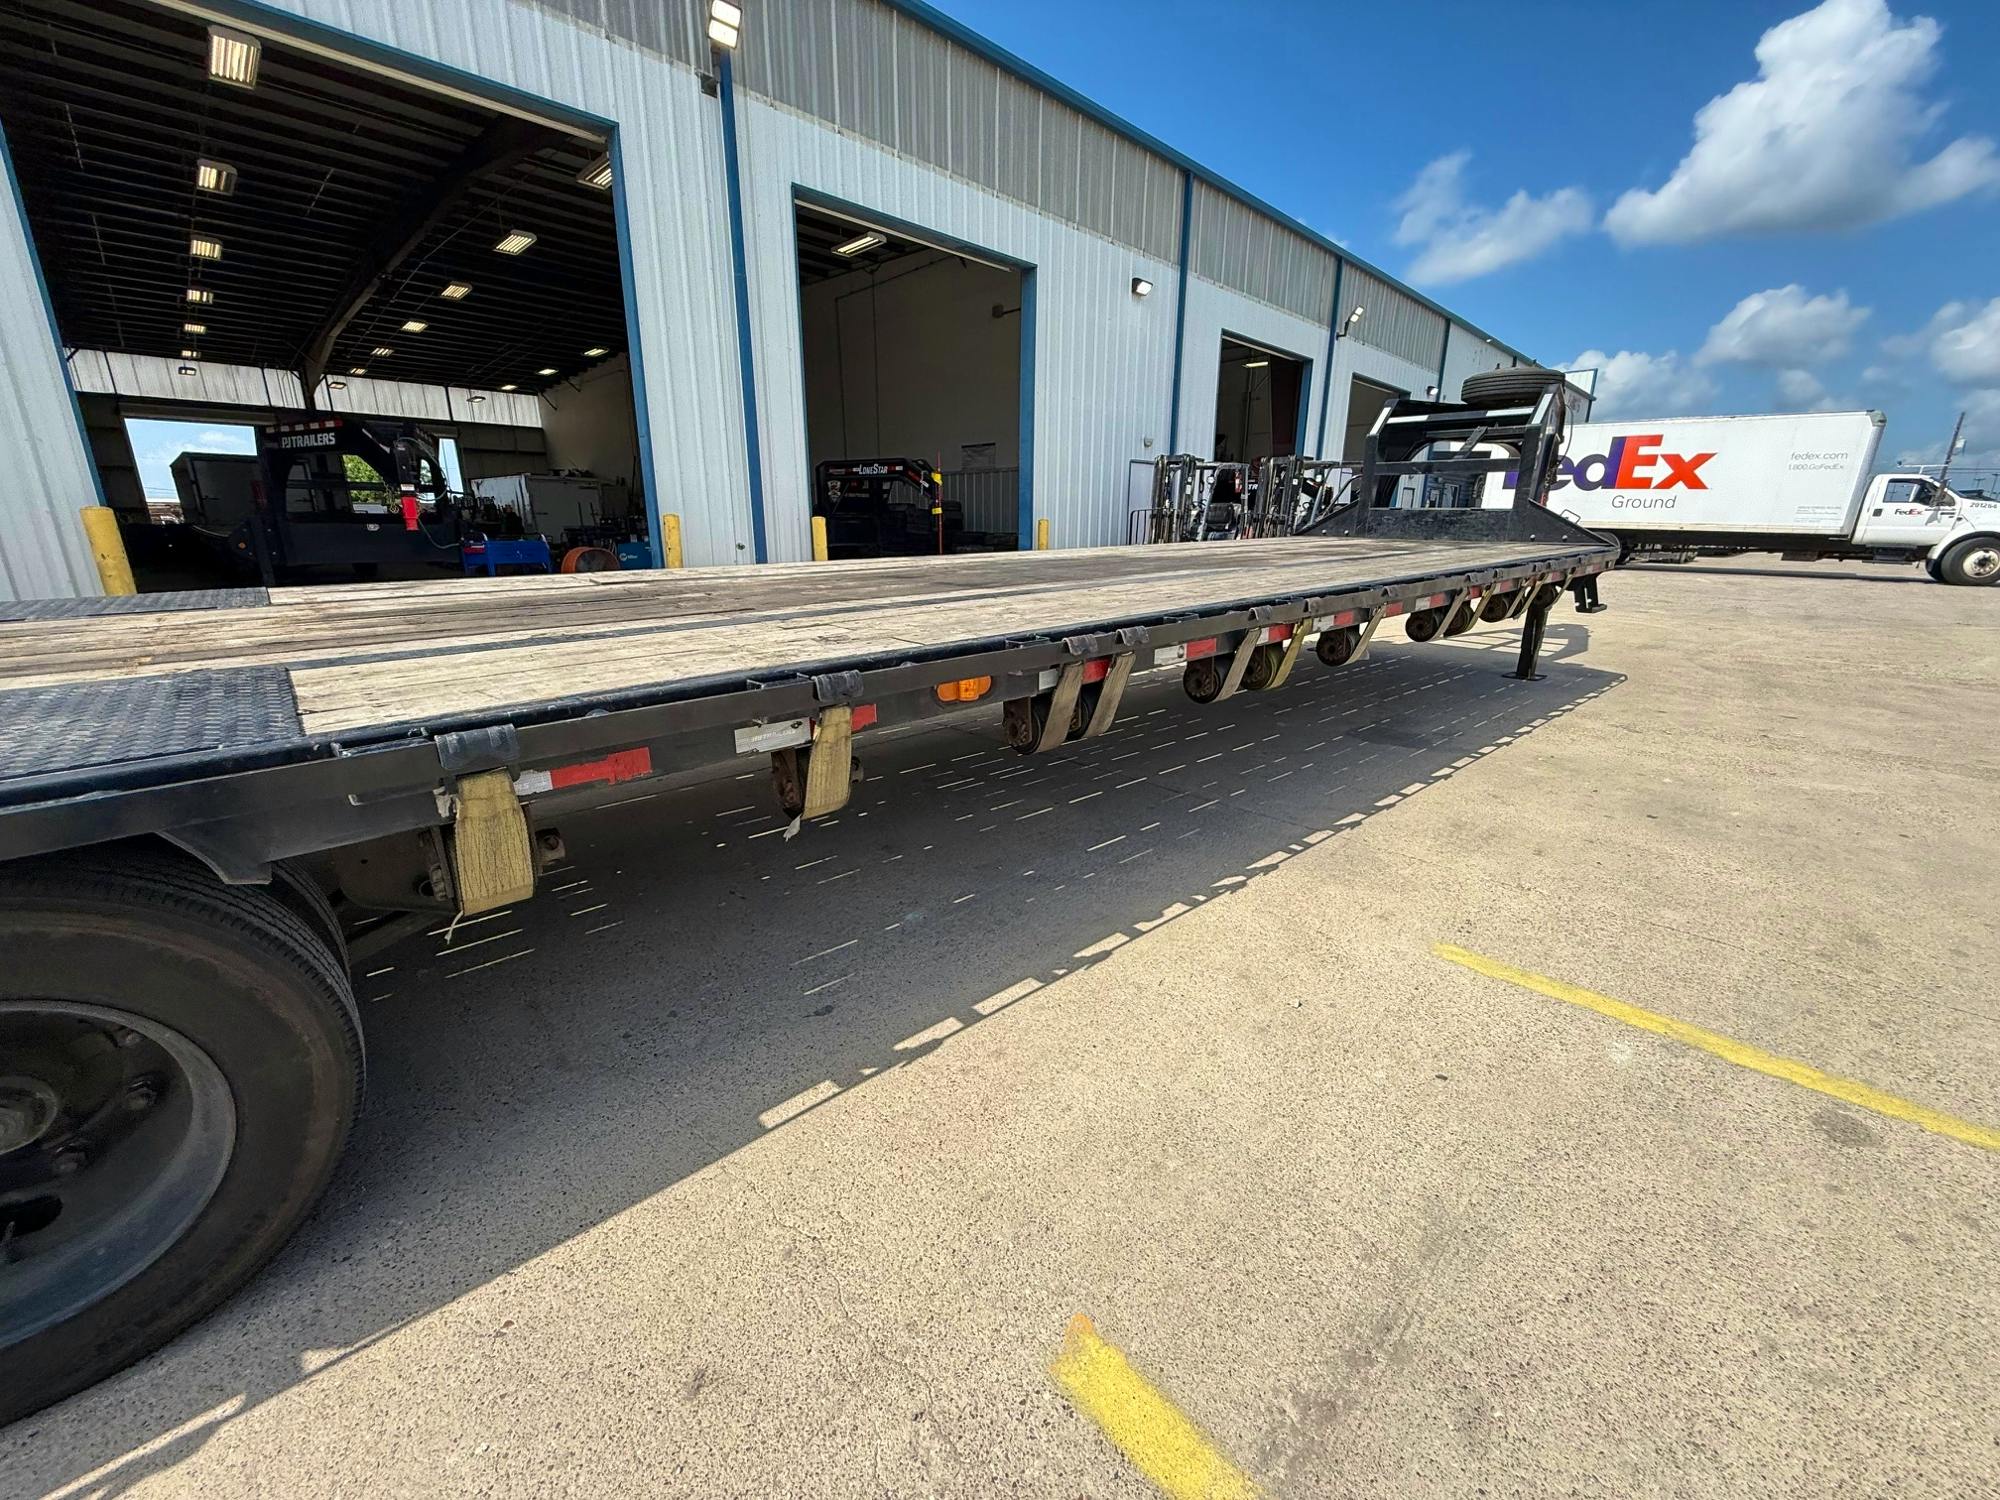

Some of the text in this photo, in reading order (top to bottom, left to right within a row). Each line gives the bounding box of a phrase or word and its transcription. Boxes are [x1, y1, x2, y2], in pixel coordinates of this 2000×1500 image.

[1790, 451, 1848, 461] fedex.com
[1611, 494, 1677, 509] Ground
[1894, 508, 1924, 516] FedEx
